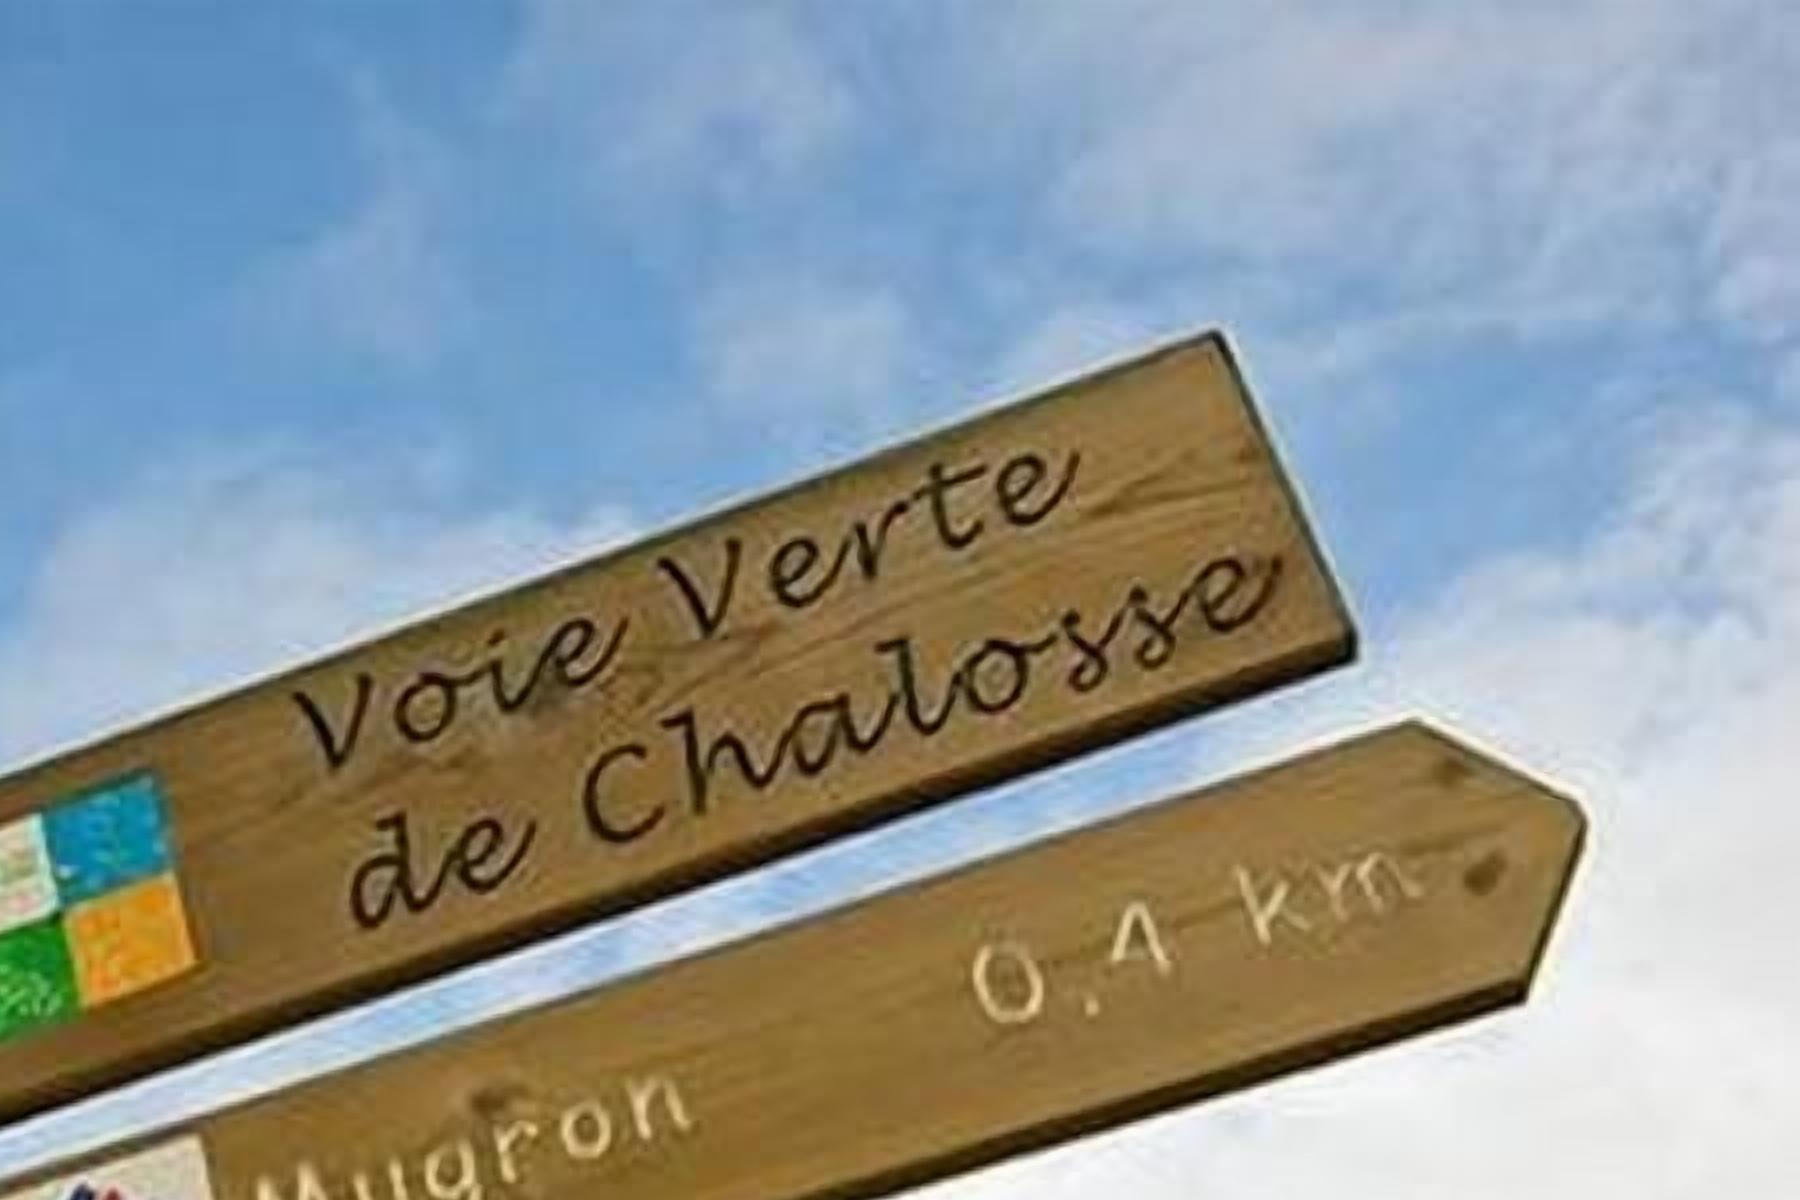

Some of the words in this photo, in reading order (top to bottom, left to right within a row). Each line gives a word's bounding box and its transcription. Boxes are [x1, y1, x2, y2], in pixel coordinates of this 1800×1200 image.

[296, 610, 632, 772] Voie
[656, 445, 1082, 640] Verte
[348, 808, 538, 930] de
[582, 550, 1286, 845] Chalosse
[1232, 848, 1426, 946] km
